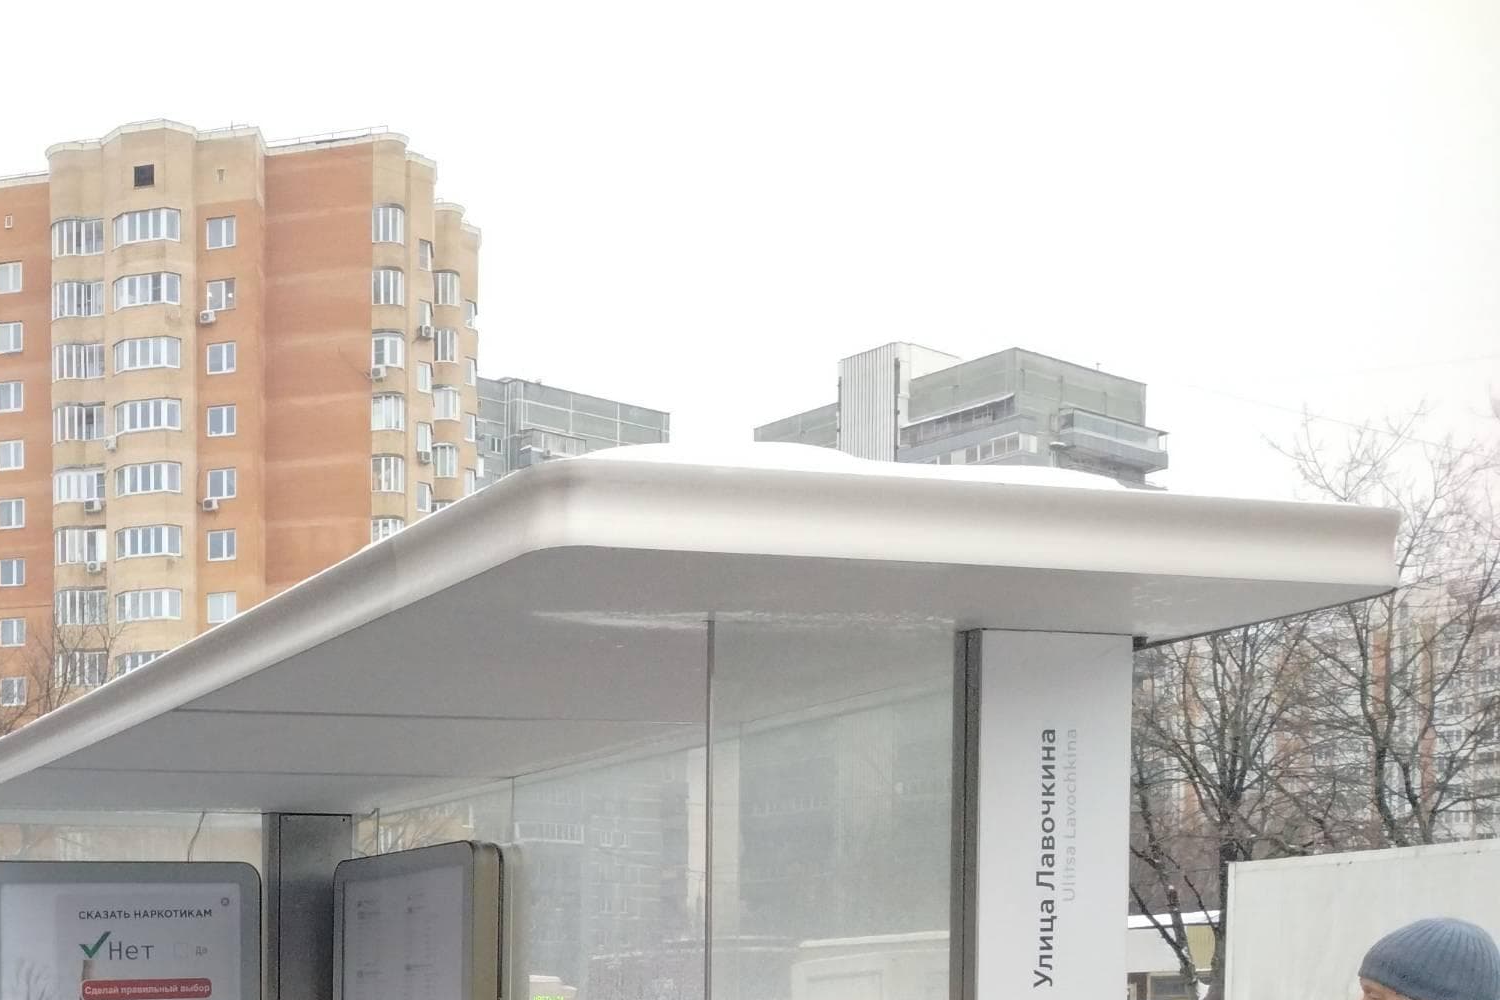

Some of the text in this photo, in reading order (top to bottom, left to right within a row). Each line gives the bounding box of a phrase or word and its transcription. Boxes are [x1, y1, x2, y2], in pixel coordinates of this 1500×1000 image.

[1062, 729, 1077, 902] Ulitsa Lavochkina
[1033, 729, 1057, 988] Улица Лавочкина
[78, 909, 212, 920] СКАЗАТЬ НАРКОТИКАМ
[108, 941, 155, 961] Нет
[84, 983, 210, 996] Сделай правильный выбор
